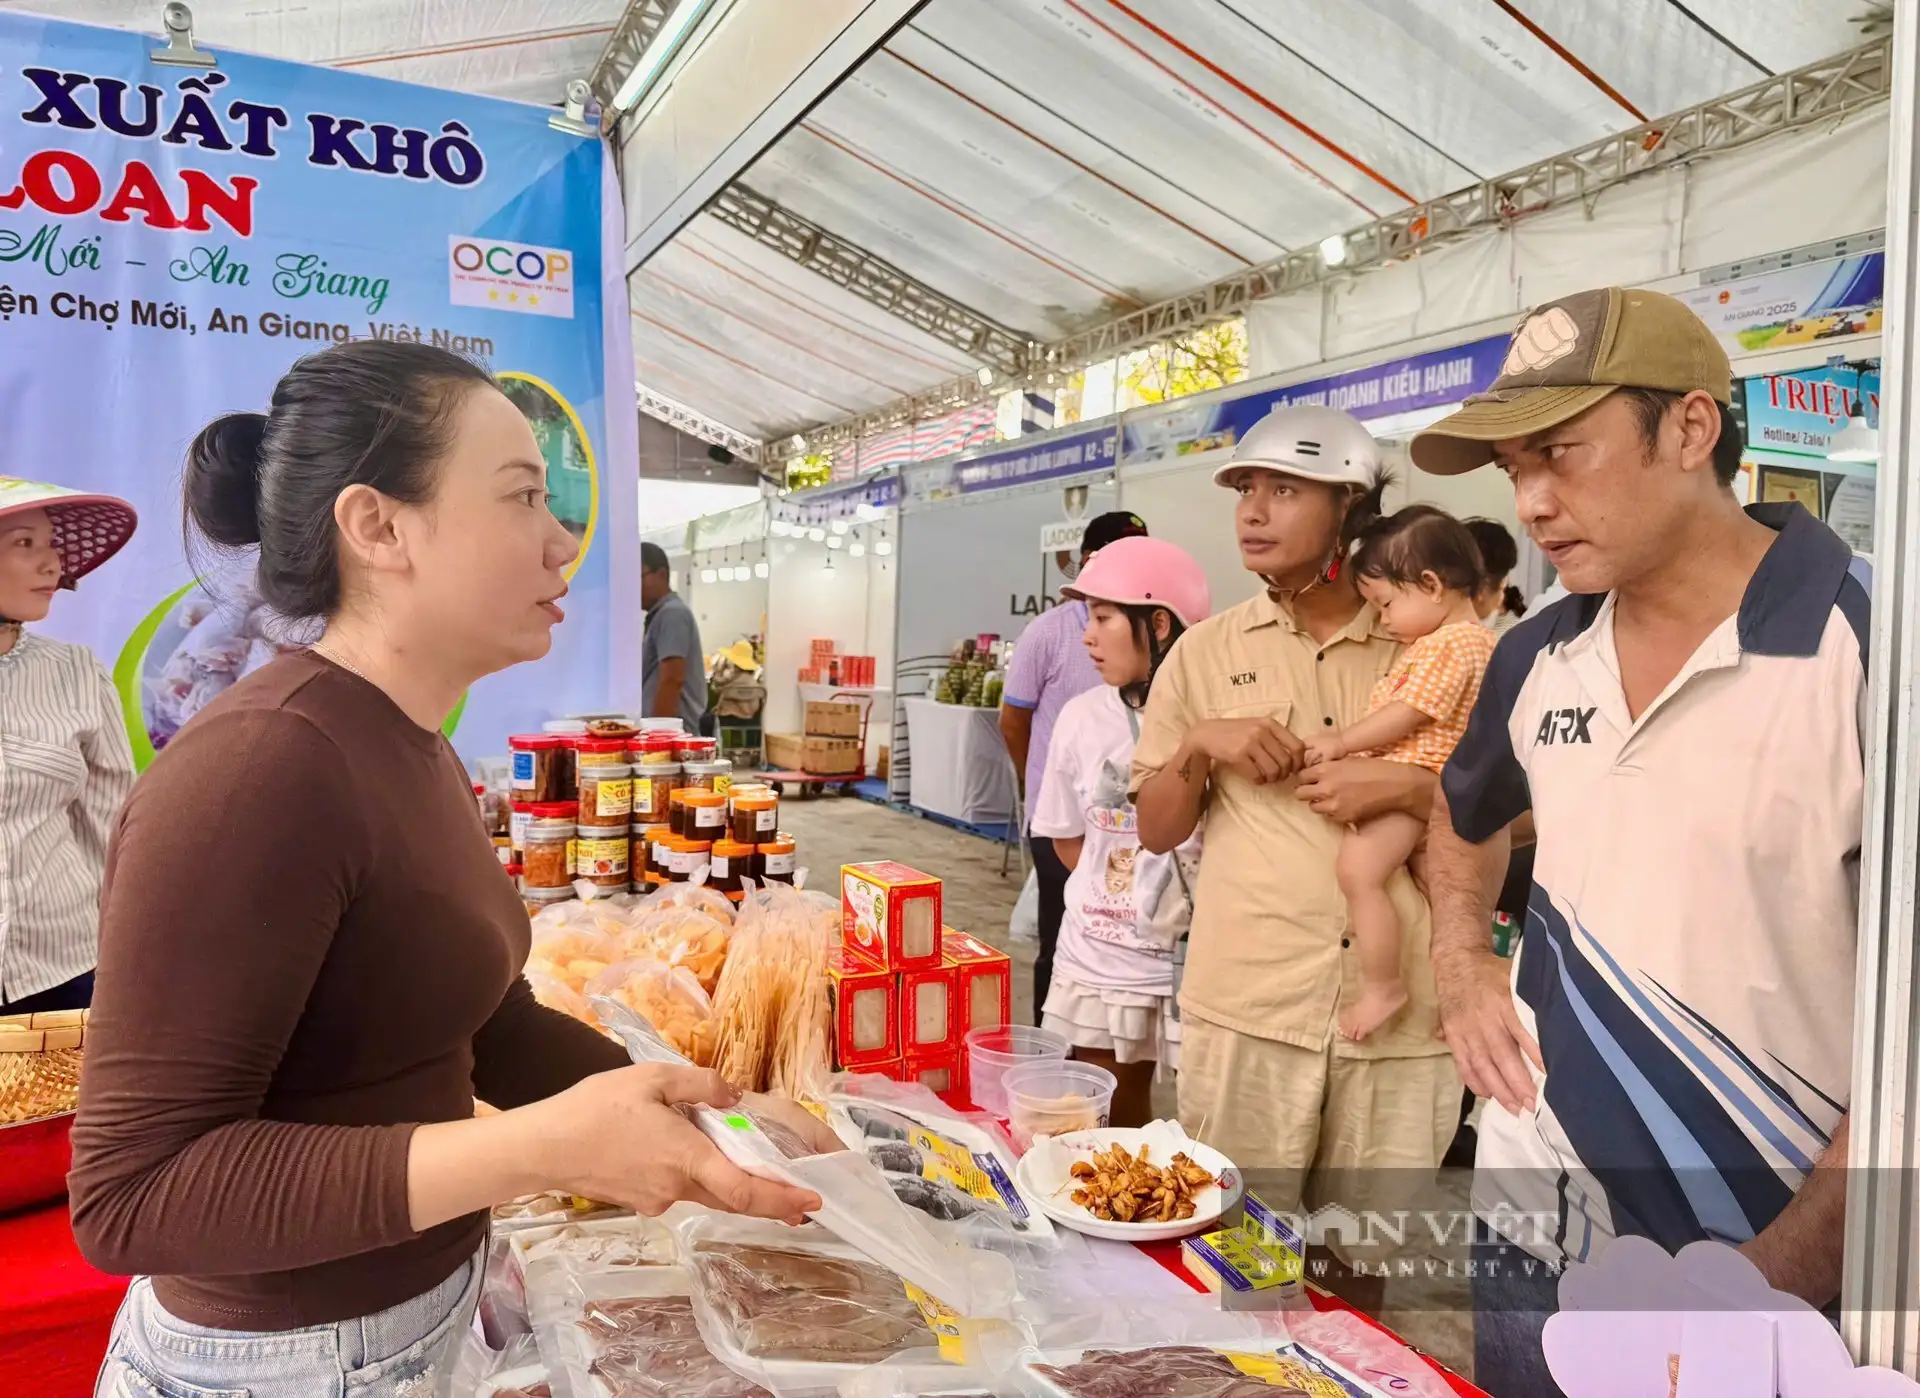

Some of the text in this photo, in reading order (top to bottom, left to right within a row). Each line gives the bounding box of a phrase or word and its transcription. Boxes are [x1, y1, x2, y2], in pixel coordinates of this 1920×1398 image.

[21, 69, 483, 185] XUẤT KHÔ
[0, 223, 102, 276] Mới
[169, 244, 250, 287] An
[272, 252, 390, 315] Giang
[453, 242, 569, 282] OCOP
[50, 291, 119, 331] Chợ
[131, 299, 196, 336] Mới,
[207, 307, 249, 335] An
[431, 327, 494, 356] Nam
[1766, 302, 1797, 317] 2025
[1424, 356, 1474, 397] HẠNH
